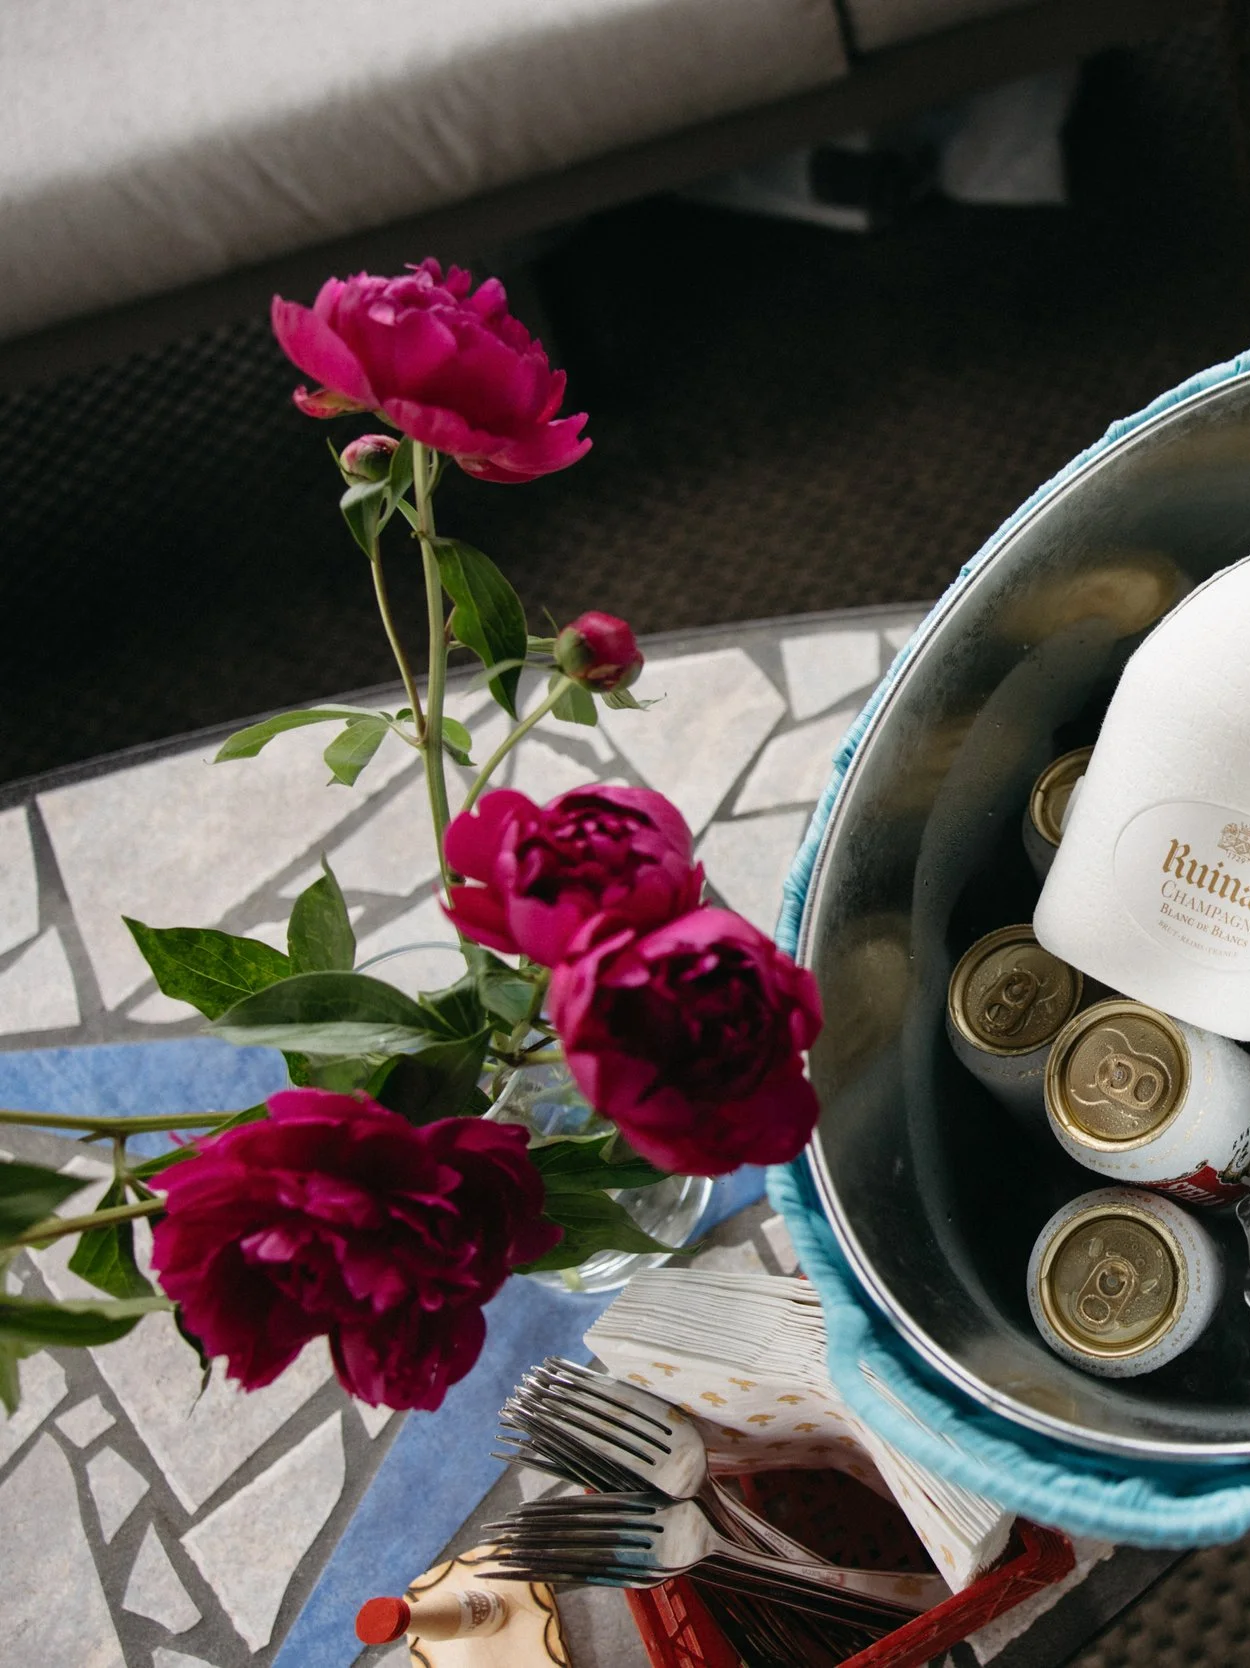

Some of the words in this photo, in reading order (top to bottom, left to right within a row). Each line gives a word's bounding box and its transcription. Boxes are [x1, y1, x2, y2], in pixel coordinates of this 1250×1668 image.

[1226, 851, 1248, 865] 1729
[1159, 902, 1194, 928] BLANC
[1210, 921, 1249, 948] BLANCS
